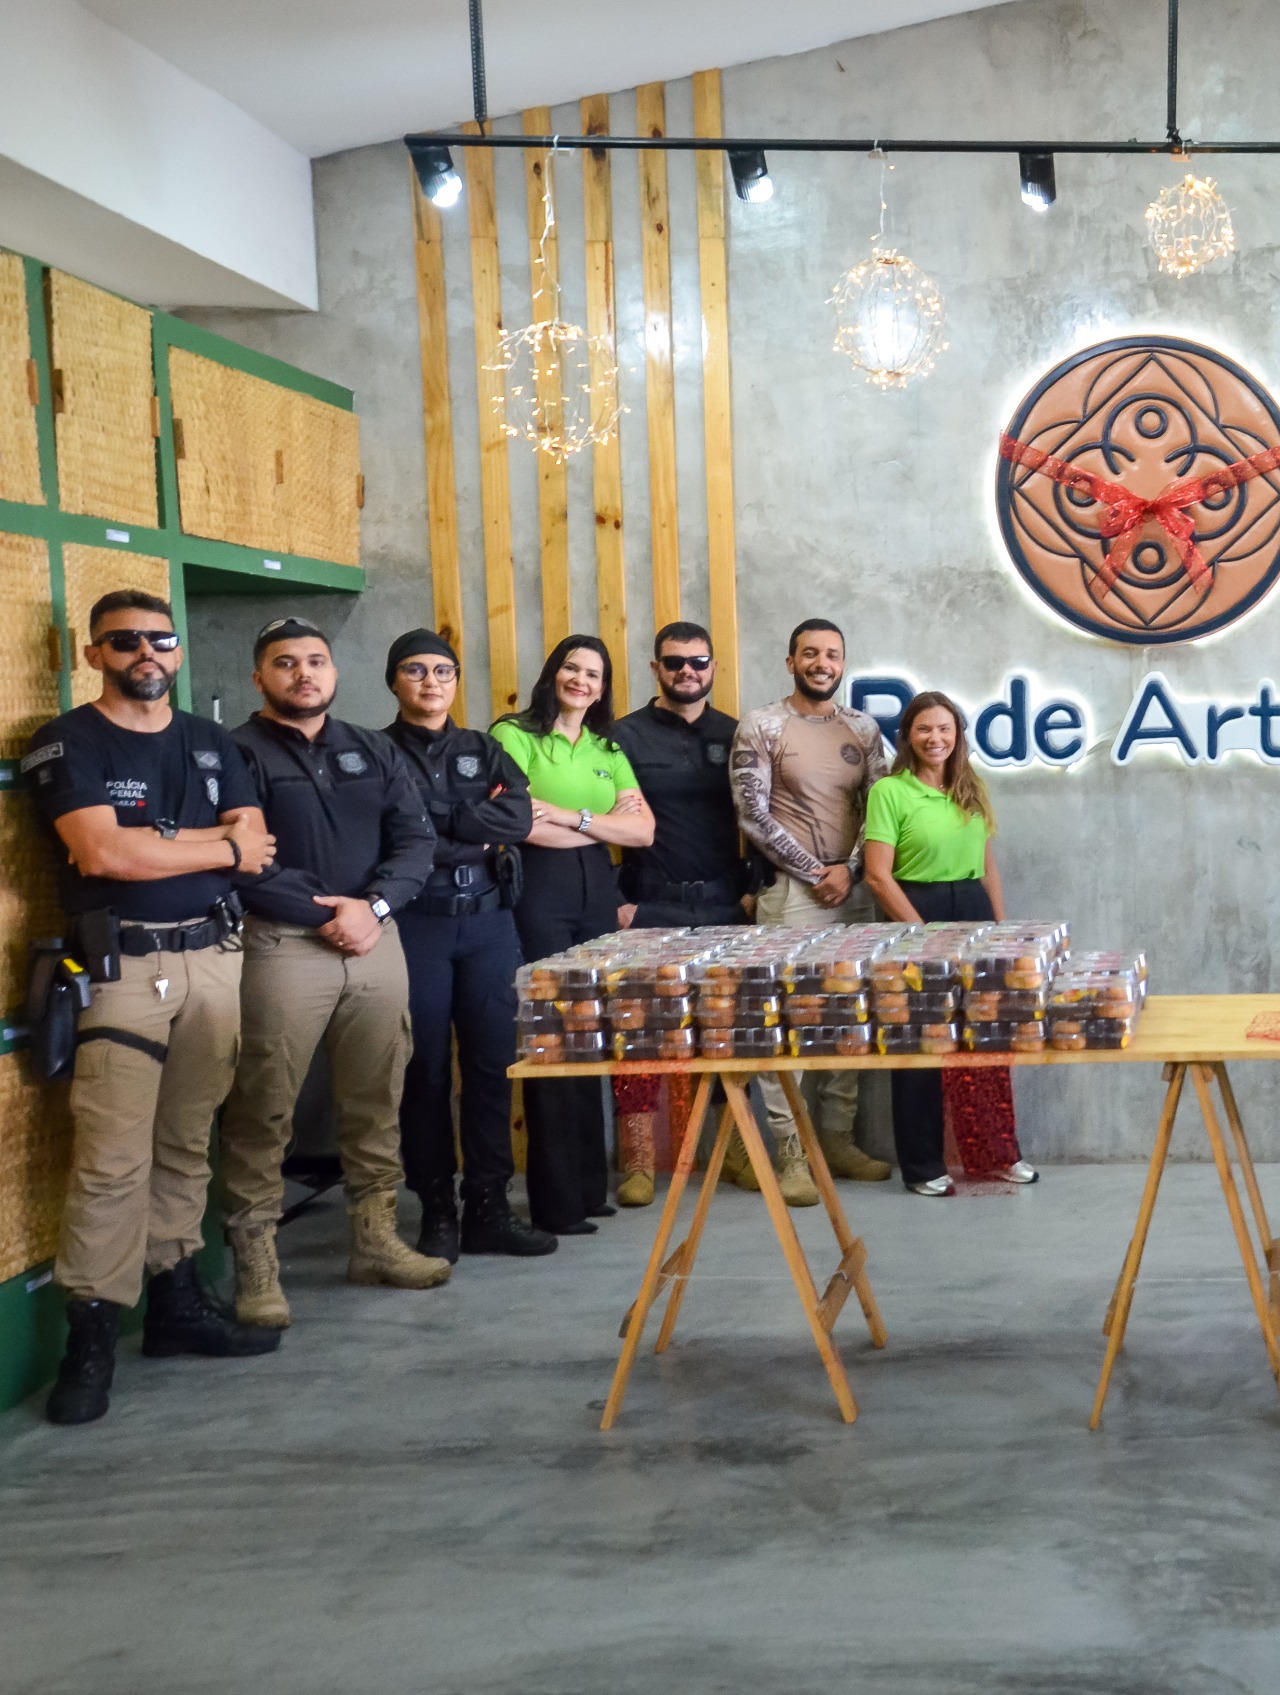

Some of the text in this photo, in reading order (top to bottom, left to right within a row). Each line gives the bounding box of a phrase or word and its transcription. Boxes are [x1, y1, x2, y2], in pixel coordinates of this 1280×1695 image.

[850, 678, 1082, 761] Rde
[106, 778, 148, 790] POLÍCIA
[110, 789, 146, 799] PENAL
